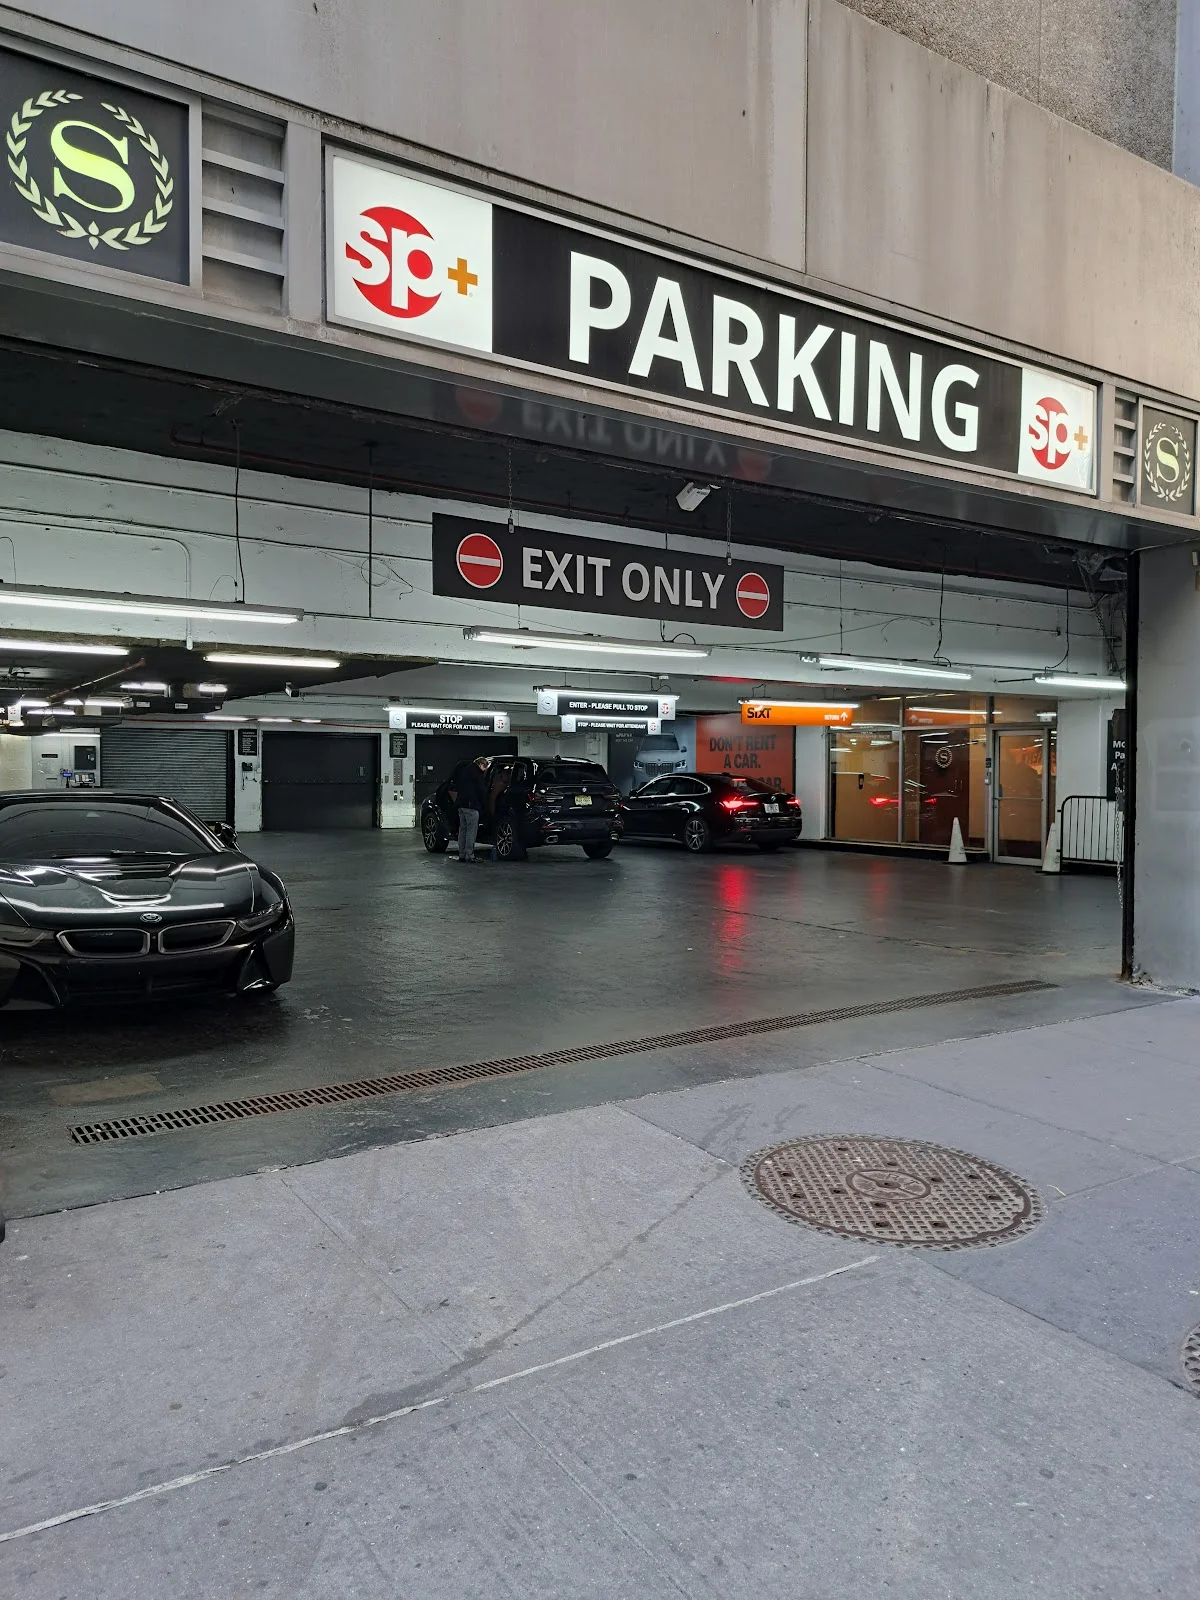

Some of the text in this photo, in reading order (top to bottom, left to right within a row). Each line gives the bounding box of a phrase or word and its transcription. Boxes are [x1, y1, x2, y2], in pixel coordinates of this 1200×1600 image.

[50, 120, 135, 213] S
[569, 250, 980, 454] PARKING
[1156, 437, 1180, 483] S
[522, 546, 726, 609] EXIT ONLY
[440, 714, 463, 724] STOP
[569, 701, 588, 709] ENTER
[709, 734, 776, 752] DON'T RENT
[723, 753, 761, 769] A CAR.
